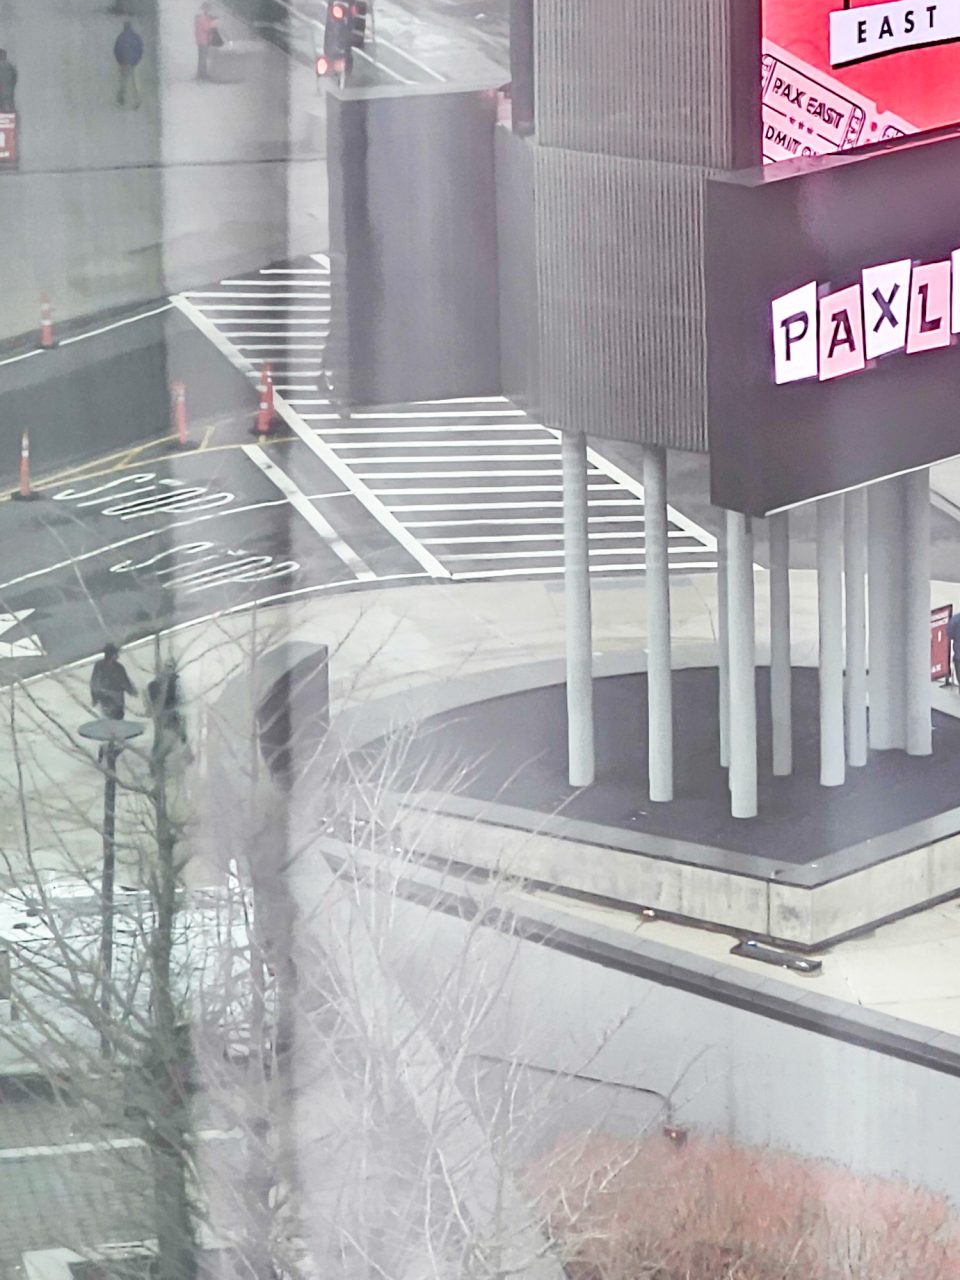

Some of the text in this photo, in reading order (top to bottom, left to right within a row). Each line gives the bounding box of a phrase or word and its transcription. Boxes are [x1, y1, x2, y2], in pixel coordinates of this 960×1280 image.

[857, 5, 938, 43] EAST
[773, 78, 844, 129] PAX EAST
[765, 125, 802, 154] DMIT
